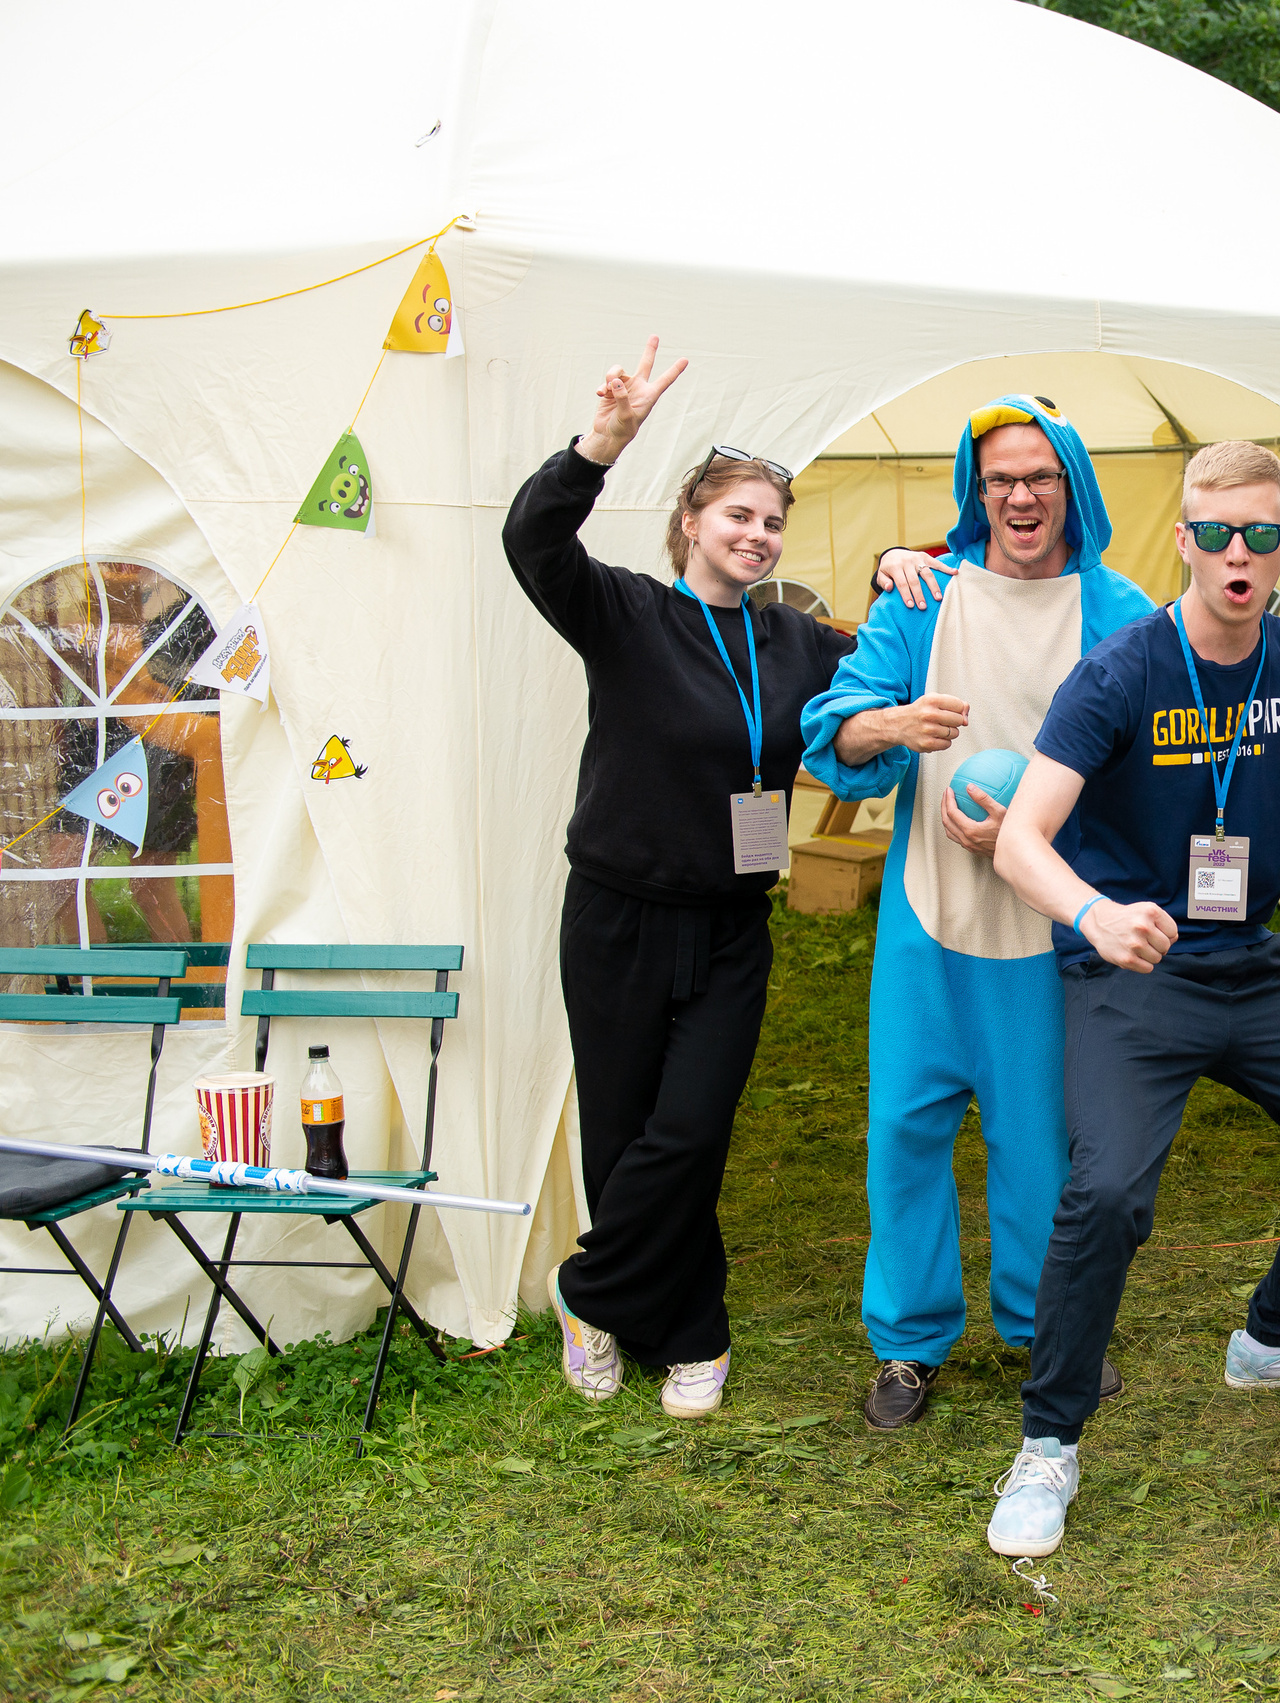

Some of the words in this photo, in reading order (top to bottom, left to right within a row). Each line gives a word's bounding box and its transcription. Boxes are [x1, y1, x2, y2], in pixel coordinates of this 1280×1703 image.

[220, 632, 259, 684] ACTIVITY
[235, 649, 262, 682] PARK
[1236, 744, 1252, 757] 016
[1208, 853, 1231, 863] fest
[1195, 905, 1239, 913] УЧАСТНИК
